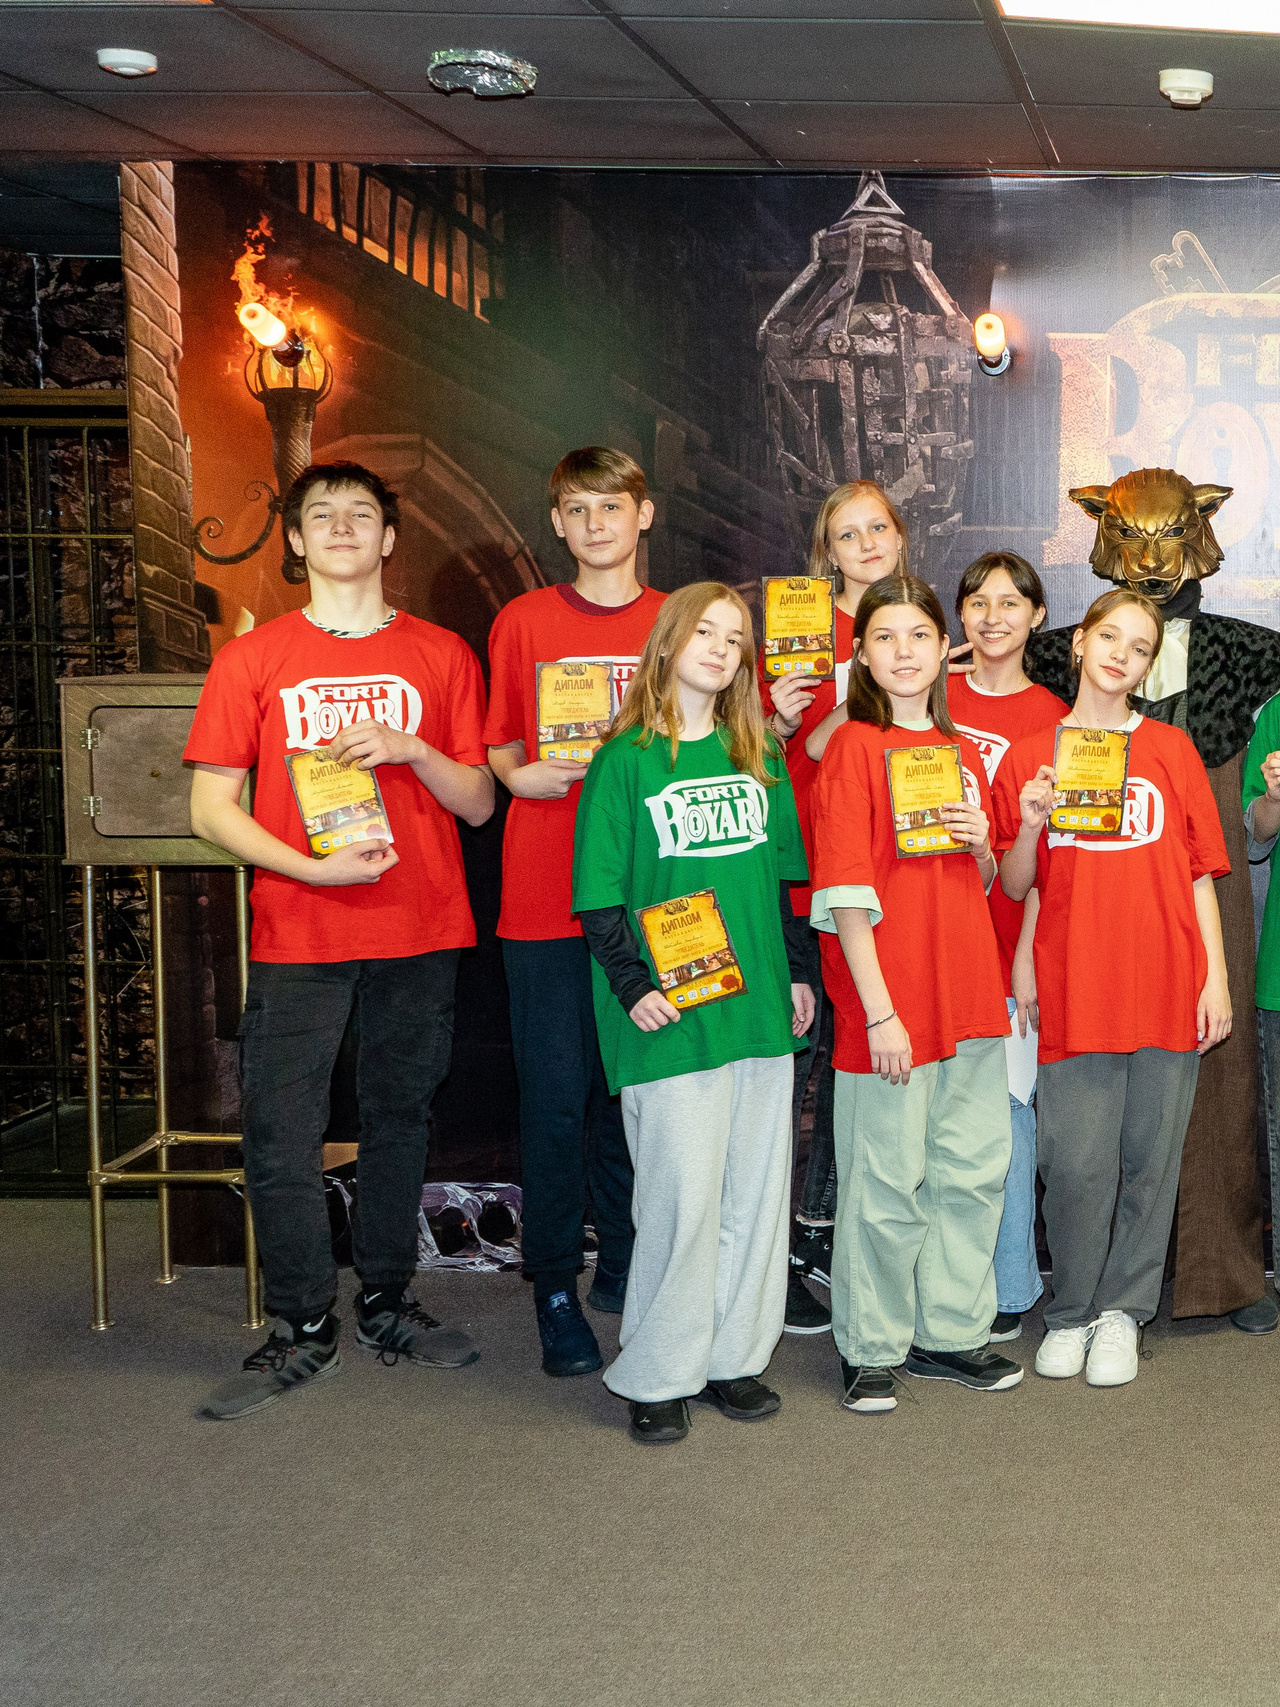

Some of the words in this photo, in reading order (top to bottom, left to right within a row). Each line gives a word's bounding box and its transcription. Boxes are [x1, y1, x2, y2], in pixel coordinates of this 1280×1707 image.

[780, 594, 816, 606] ДИПЛОМ
[318, 684, 384, 701] FORT
[554, 679, 593, 692] ДИПЛОМ
[1072, 745, 1110, 758] ДИПЛОМ
[906, 763, 943, 778] ДИПЛОМ
[682, 783, 741, 803] FORT
[644, 774, 768, 859] BOYARD
[661, 911, 702, 935] ДИПЛОМ
